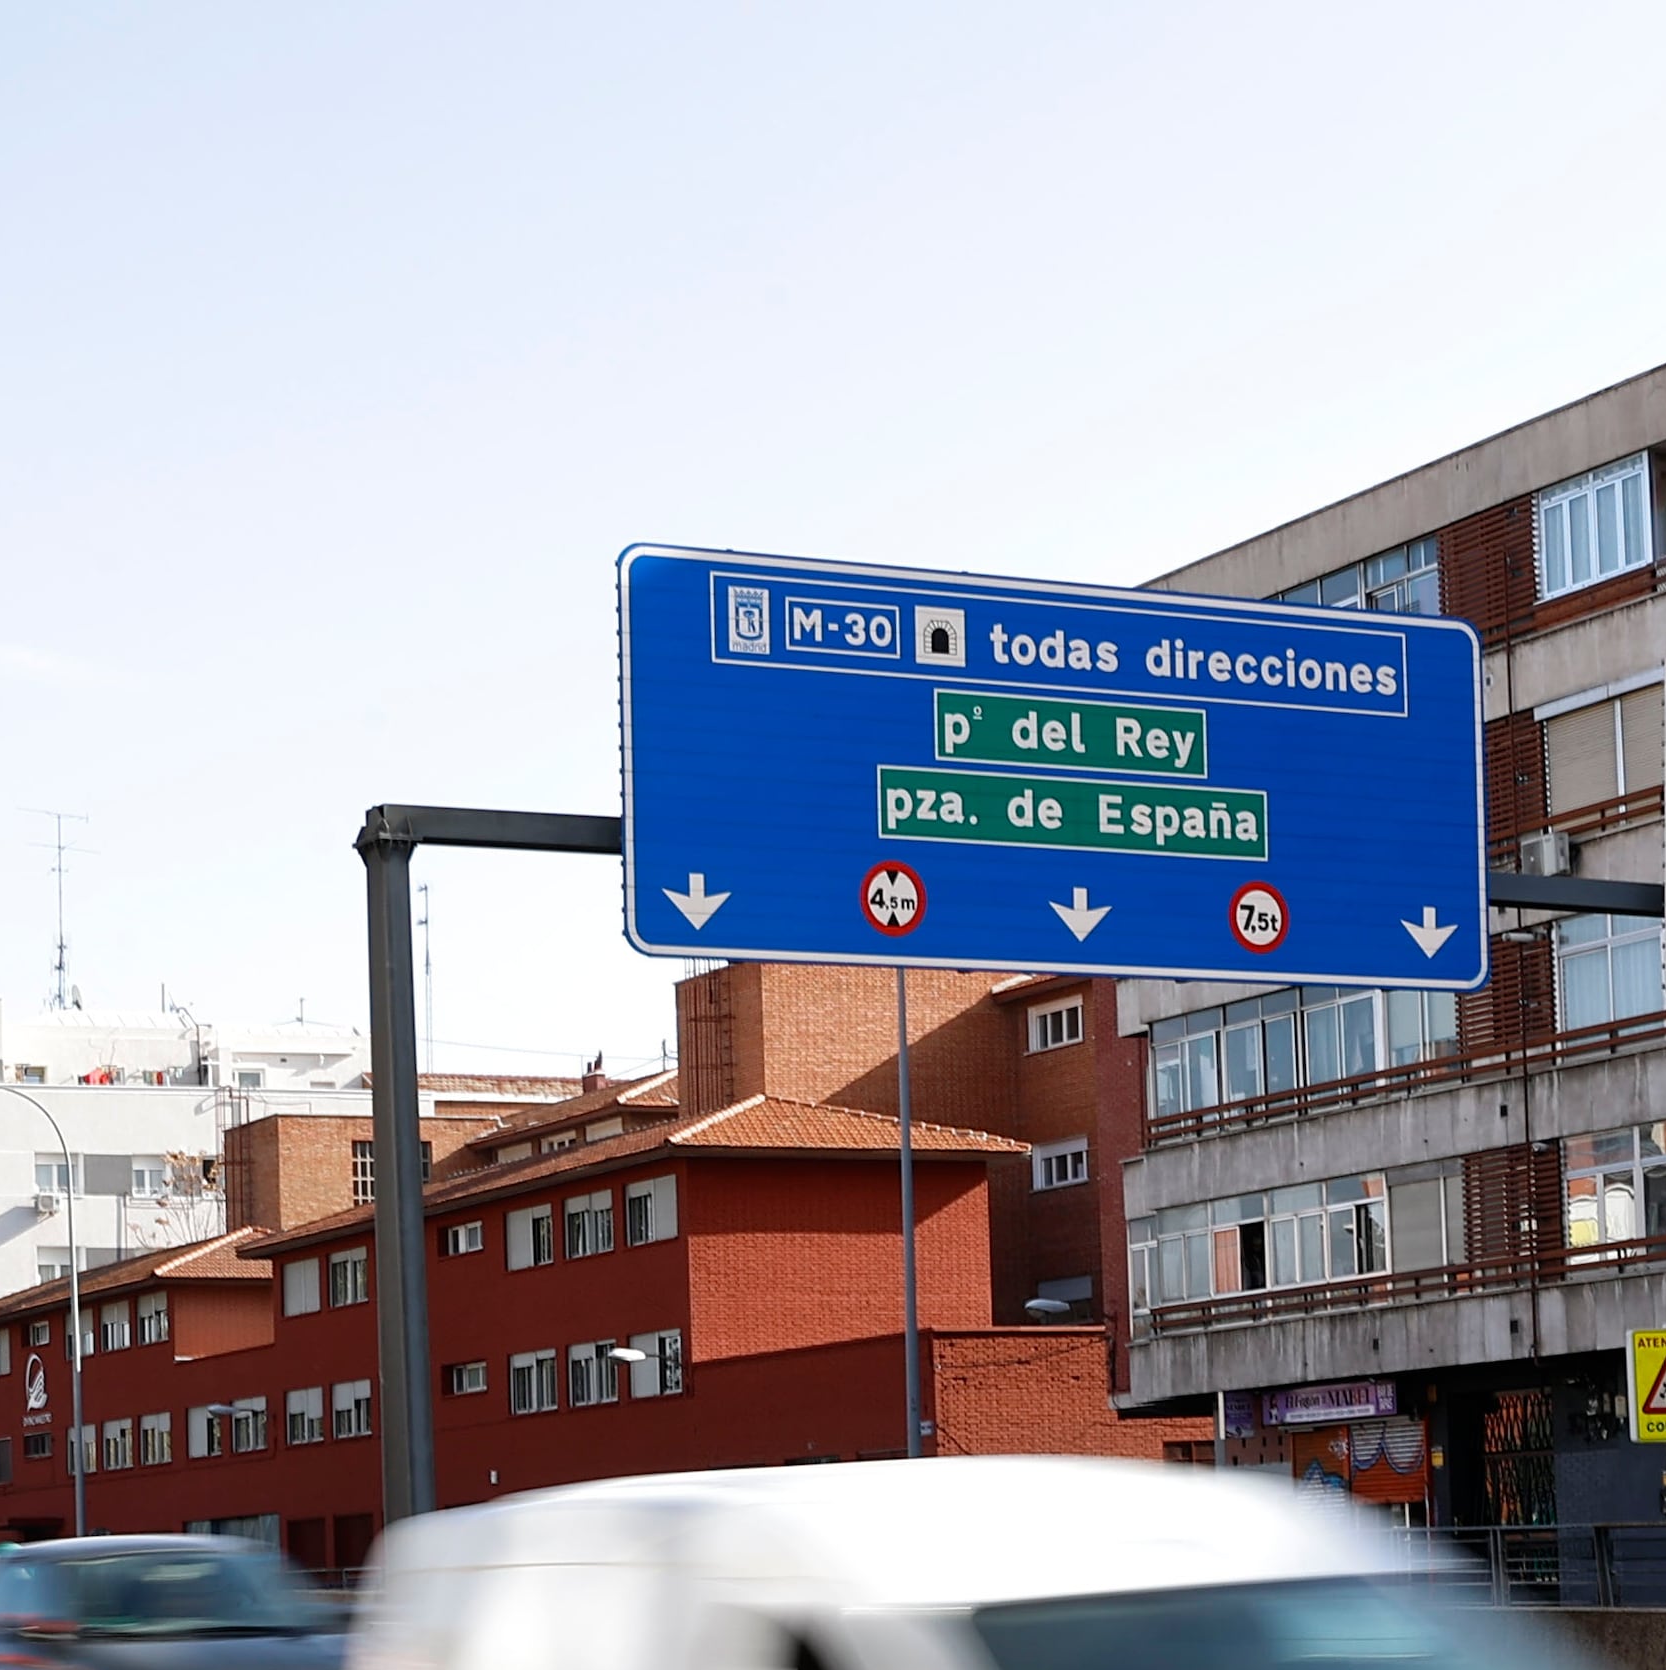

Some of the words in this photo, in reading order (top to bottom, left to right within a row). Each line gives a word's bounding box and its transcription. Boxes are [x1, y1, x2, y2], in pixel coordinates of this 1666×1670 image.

[732, 640, 767, 653] madrid
[793, 607, 892, 648] M-30
[989, 623, 1119, 673] todas
[1145, 638, 1397, 696] direcciones
[1012, 711, 1086, 753] del
[1116, 717, 1195, 768] Rey
[886, 788, 978, 829] pza.
[1007, 789, 1063, 829] de
[1098, 794, 1259, 846] España
